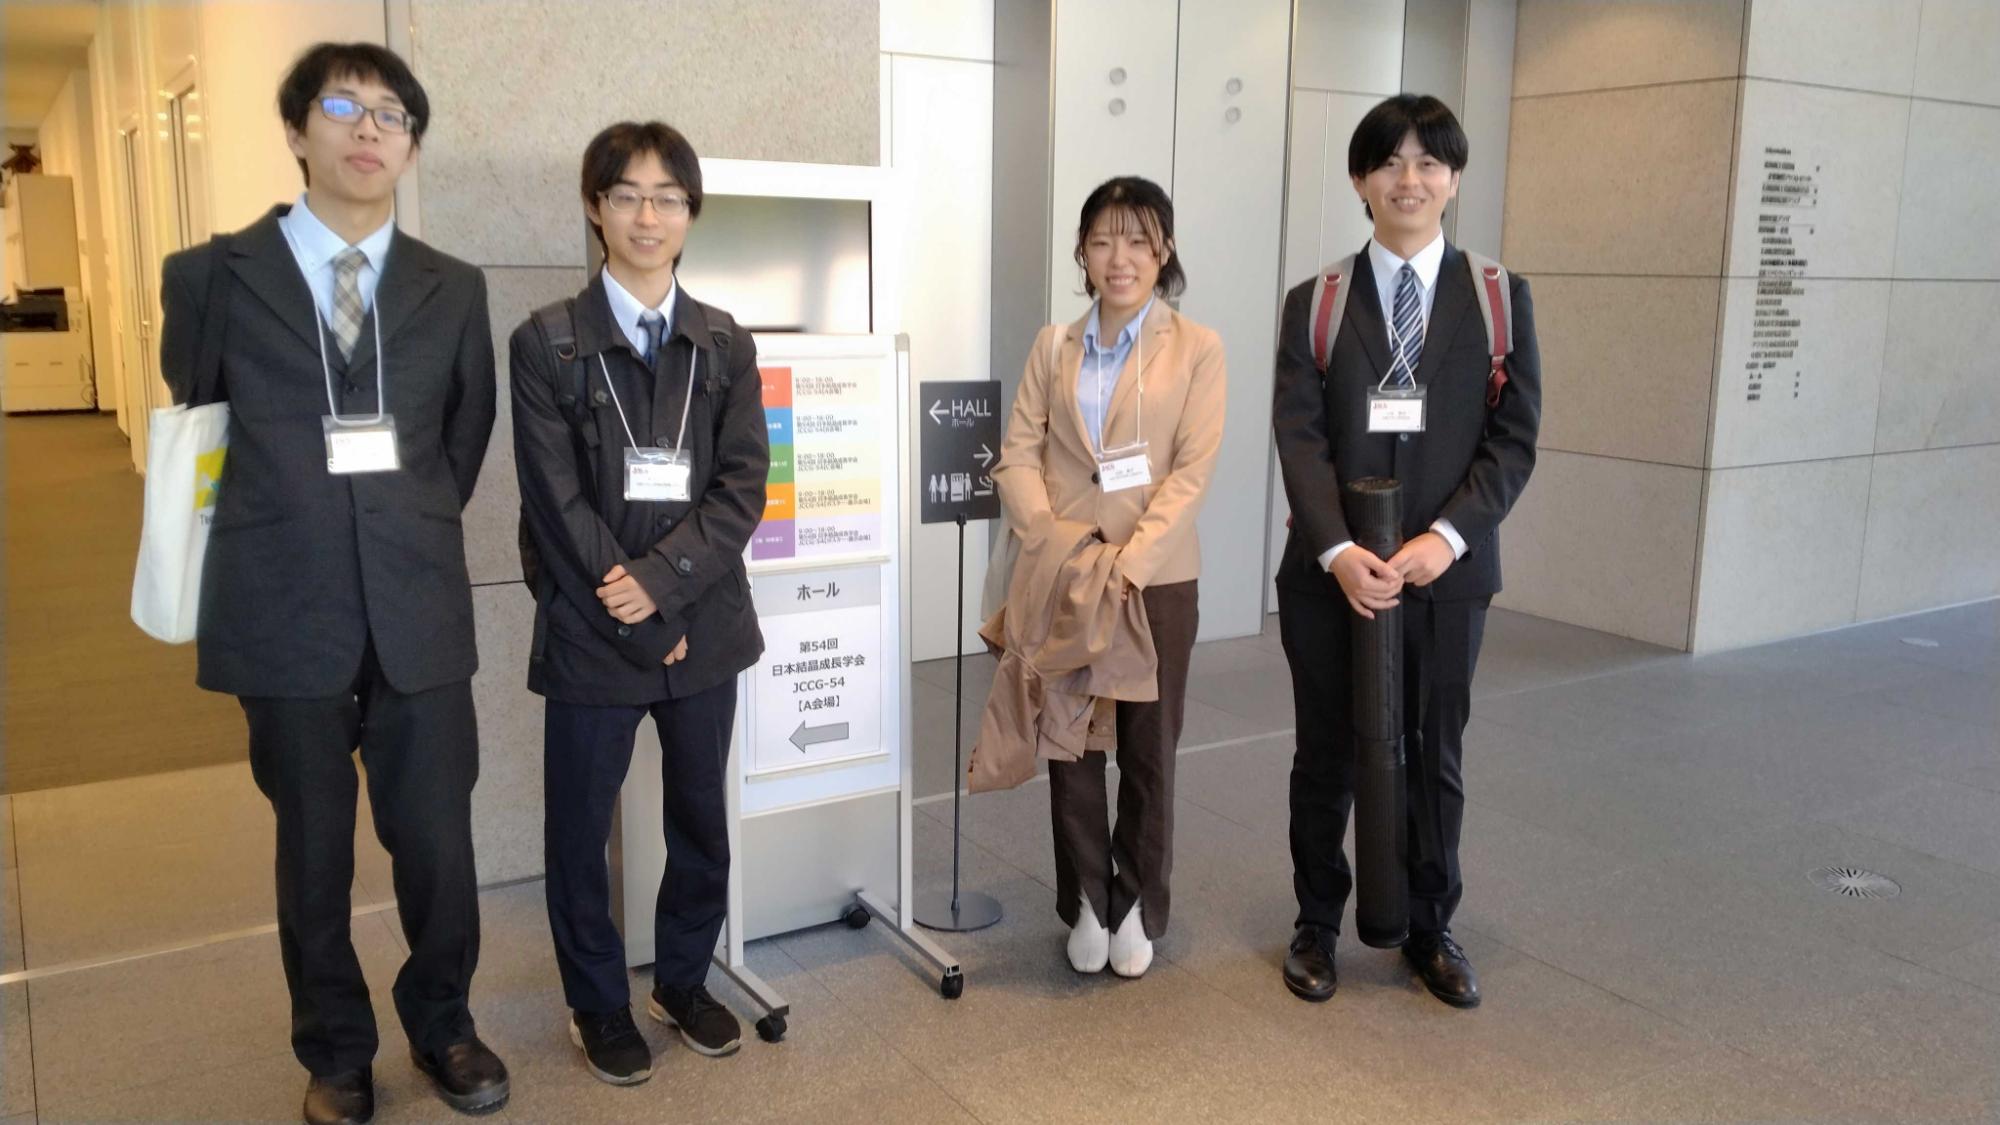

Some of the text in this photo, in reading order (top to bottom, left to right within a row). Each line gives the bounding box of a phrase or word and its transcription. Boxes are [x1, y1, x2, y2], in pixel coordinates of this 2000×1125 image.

[952, 399, 991, 417] HALL
[951, 418, 974, 427] ホール
[797, 582, 840, 601] ホール
[800, 638, 838, 654] 第54回
[773, 654, 866, 677] 日本結晶成長学会
[793, 676, 844, 693] JCCG-54
